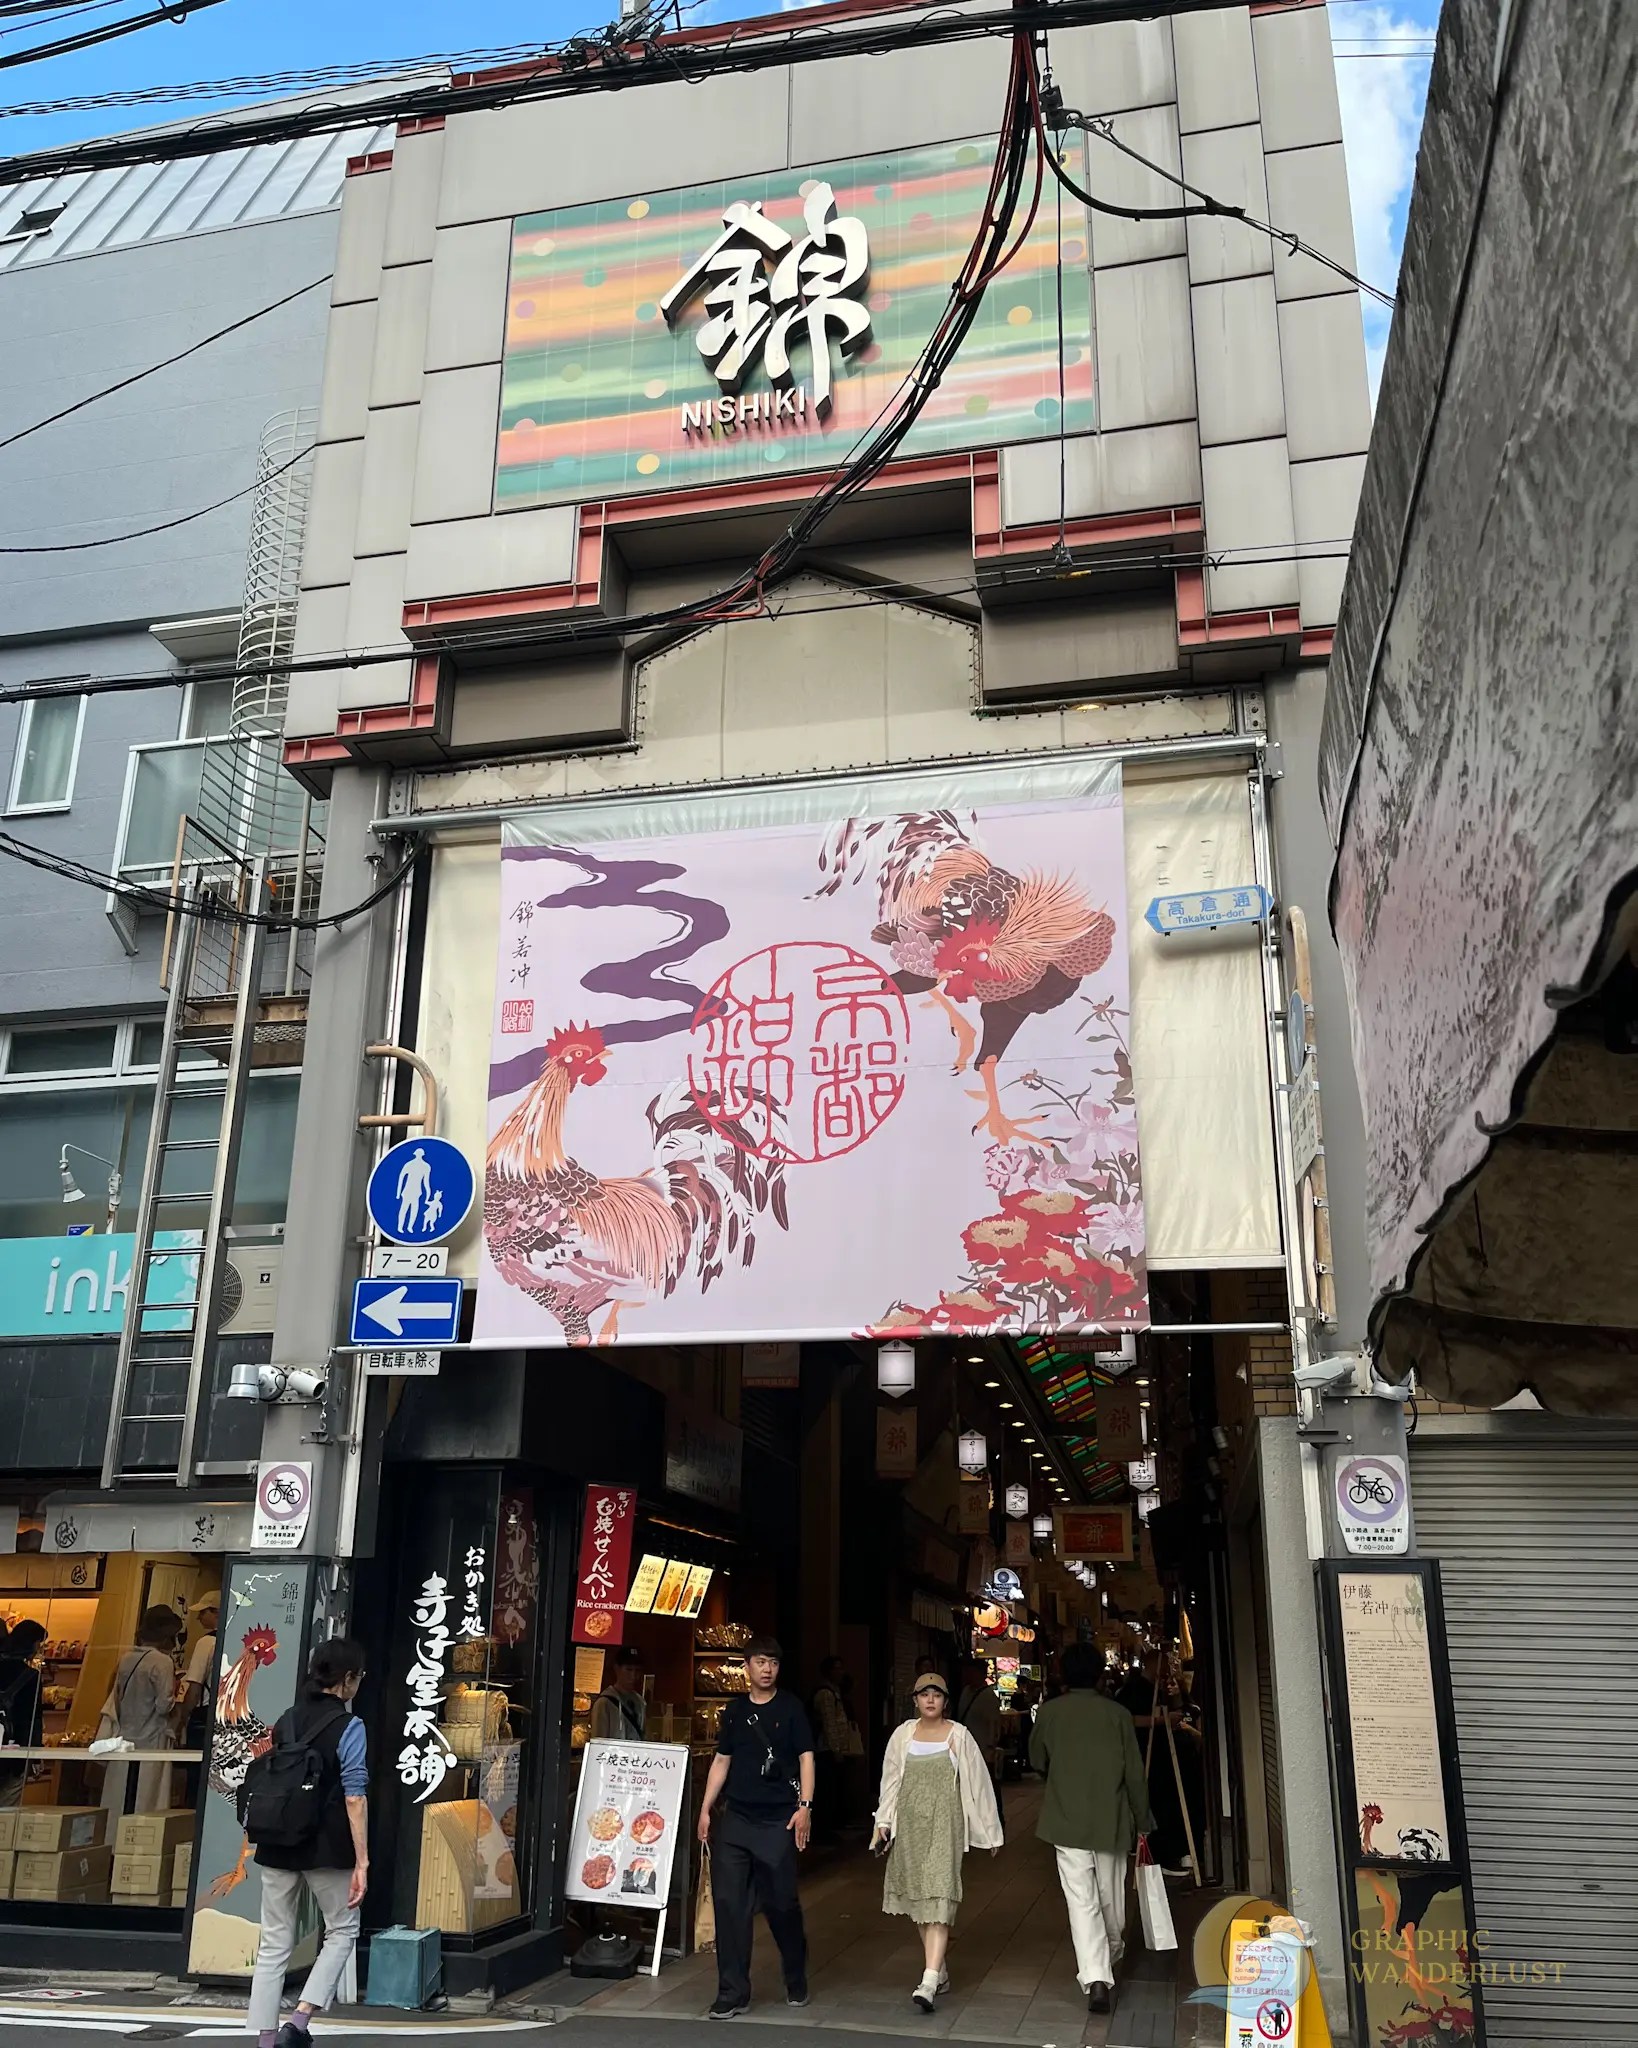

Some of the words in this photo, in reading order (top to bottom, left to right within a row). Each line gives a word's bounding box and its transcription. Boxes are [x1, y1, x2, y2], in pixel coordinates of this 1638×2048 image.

[660, 182, 871, 410] 錦
[681, 386, 806, 431] NISHIKI
[1167, 892, 1252, 916] 高倉通
[1176, 908, 1246, 925] Takakura-dori
[370, 1352, 435, 1368] 自転車を除く
[455, 1545, 486, 1637] おかき処
[1343, 1584, 1373, 1599] 伊藤
[282, 1582, 299, 1626] 錦市場
[577, 1600, 594, 1609] Rice
[594, 1601, 625, 1611] crackers
[1360, 1601, 1389, 1615] 若冲
[595, 1752, 676, 1770] 手焼きせんべい
